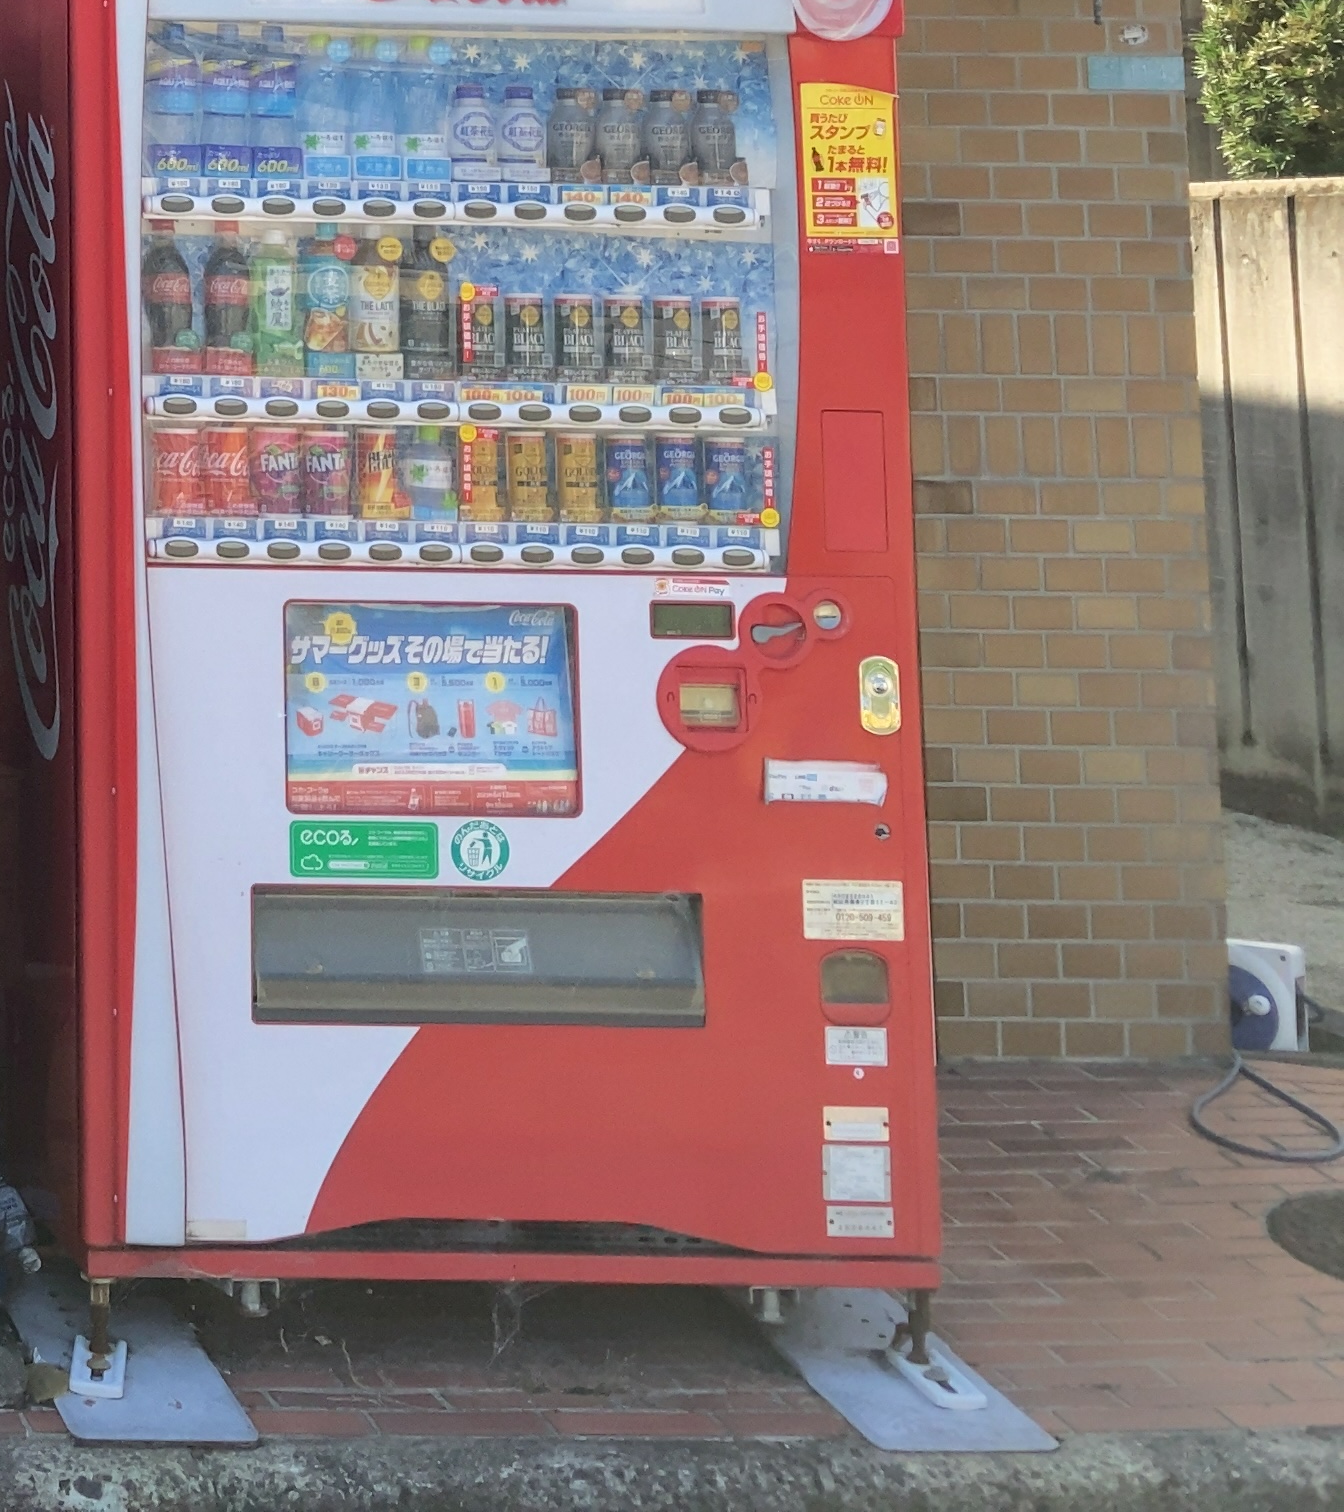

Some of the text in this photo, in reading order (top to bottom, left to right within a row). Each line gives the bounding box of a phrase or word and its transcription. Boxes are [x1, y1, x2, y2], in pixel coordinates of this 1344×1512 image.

[820, 93, 874, 106] Coke ON
[810, 113, 848, 124] 買うたび
[810, 124, 871, 140] スタンプ
[827, 145, 866, 155] たまると
[257, 159, 299, 174] 600ml
[827, 156, 888, 173] 1本無料!
[569, 389, 606, 401] 100円
[3, 79, 61, 762] Coca-Cola
[708, 586, 725, 596] Pay
[508, 609, 555, 627] Coca-Cola
[454, 820, 505, 845] のんだあとは
[458, 862, 503, 880] リサイクル
